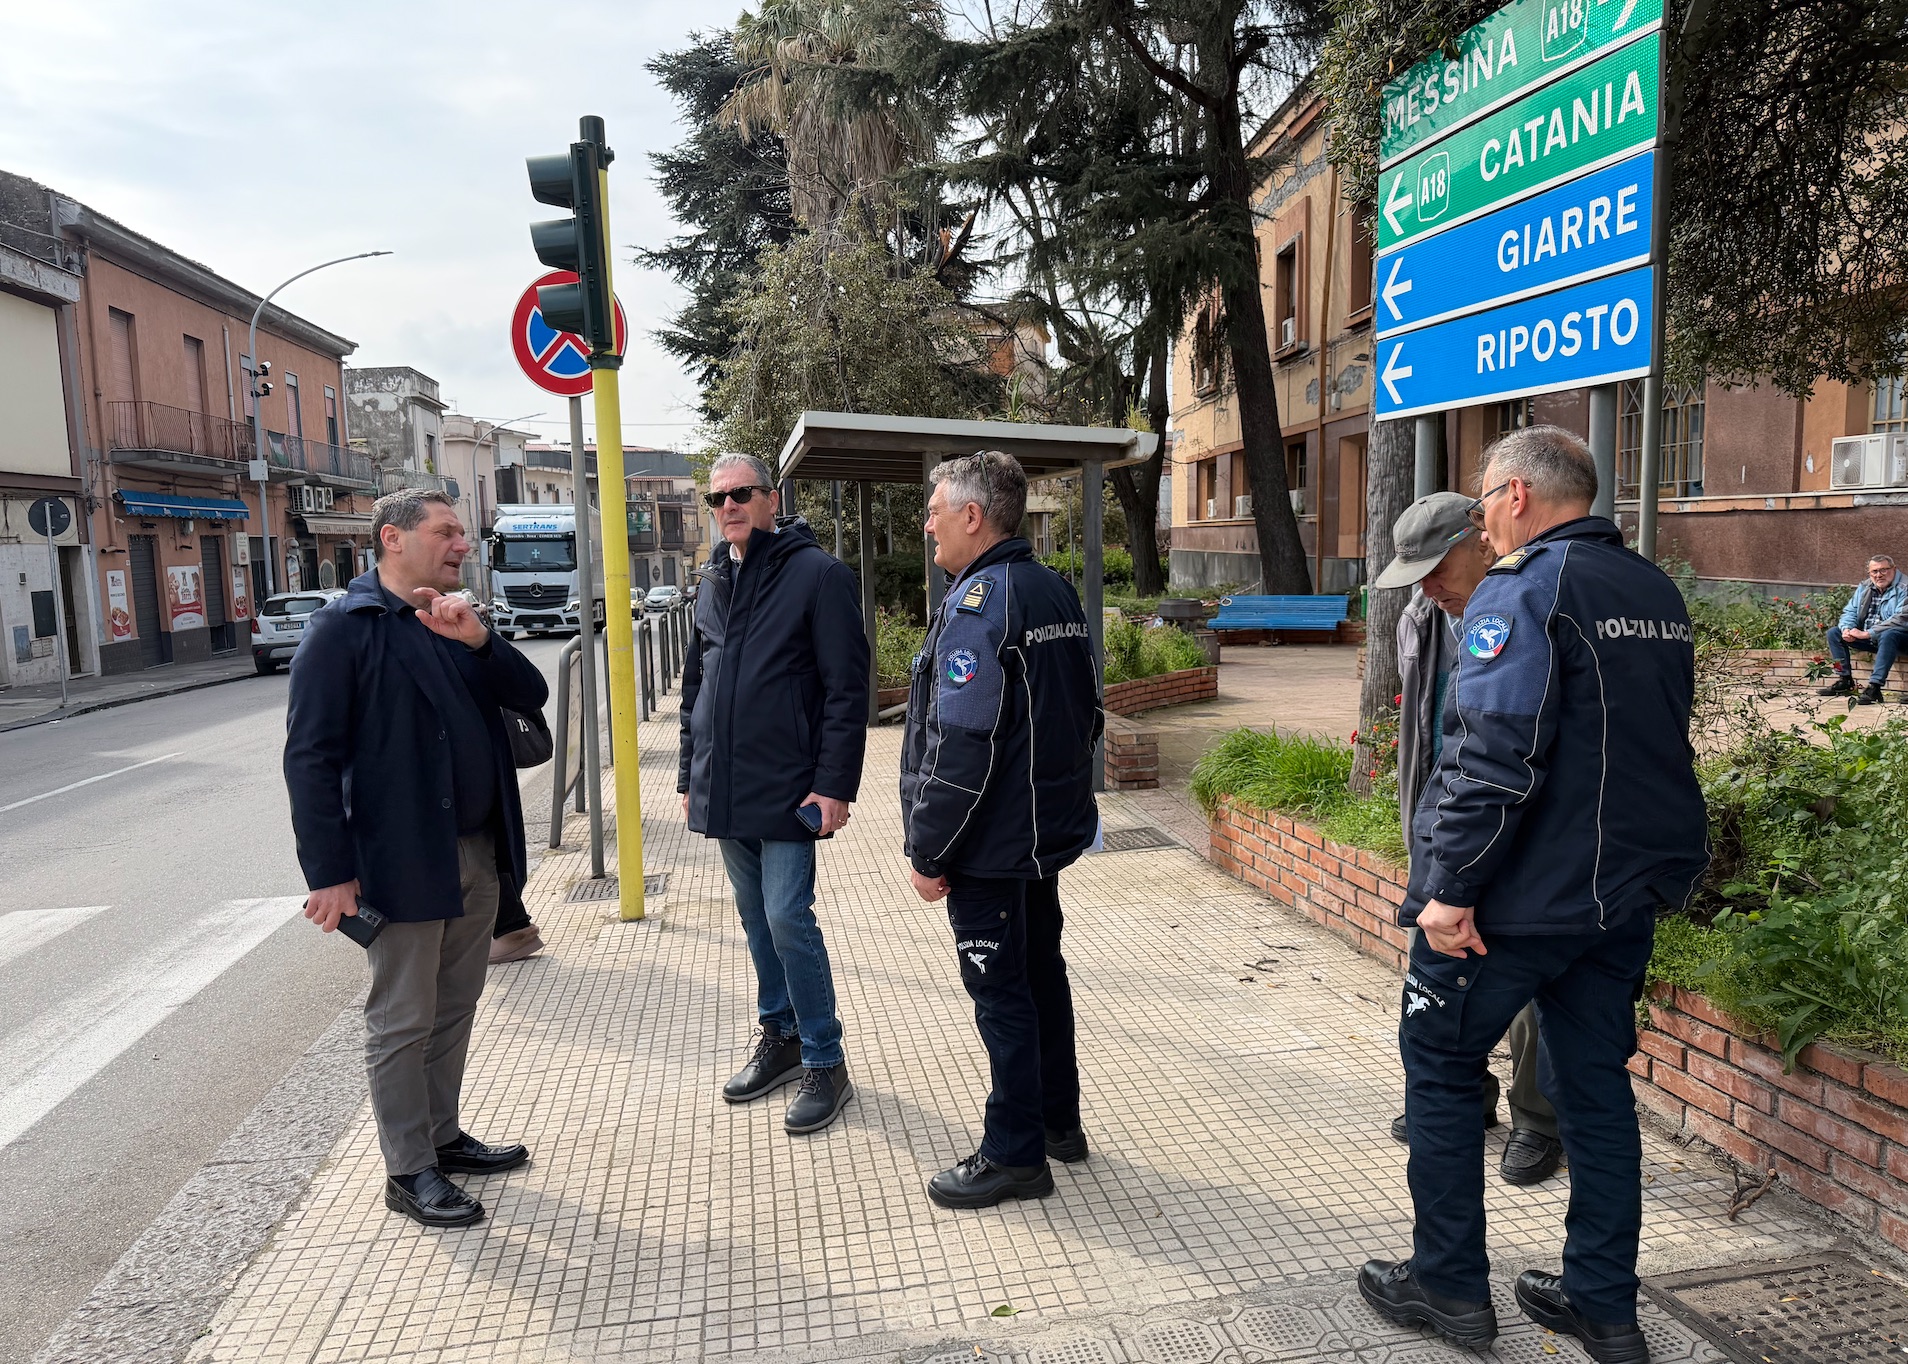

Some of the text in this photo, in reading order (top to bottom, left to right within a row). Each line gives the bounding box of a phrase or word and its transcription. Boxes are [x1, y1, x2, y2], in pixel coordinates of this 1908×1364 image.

[1385, 0, 1583, 138] MESSINA A18
[1420, 69, 1646, 207] A18 CATANIA
[1497, 183, 1639, 273] GIARRE
[1477, 298, 1639, 374] RIPOSTO
[1470, 617, 1509, 634] POLIZIA LOCALE
[1595, 616, 1659, 640] POLZIA
[975, 939, 1000, 951] LOCALE
[1418, 982, 1446, 1008] LOCALE
